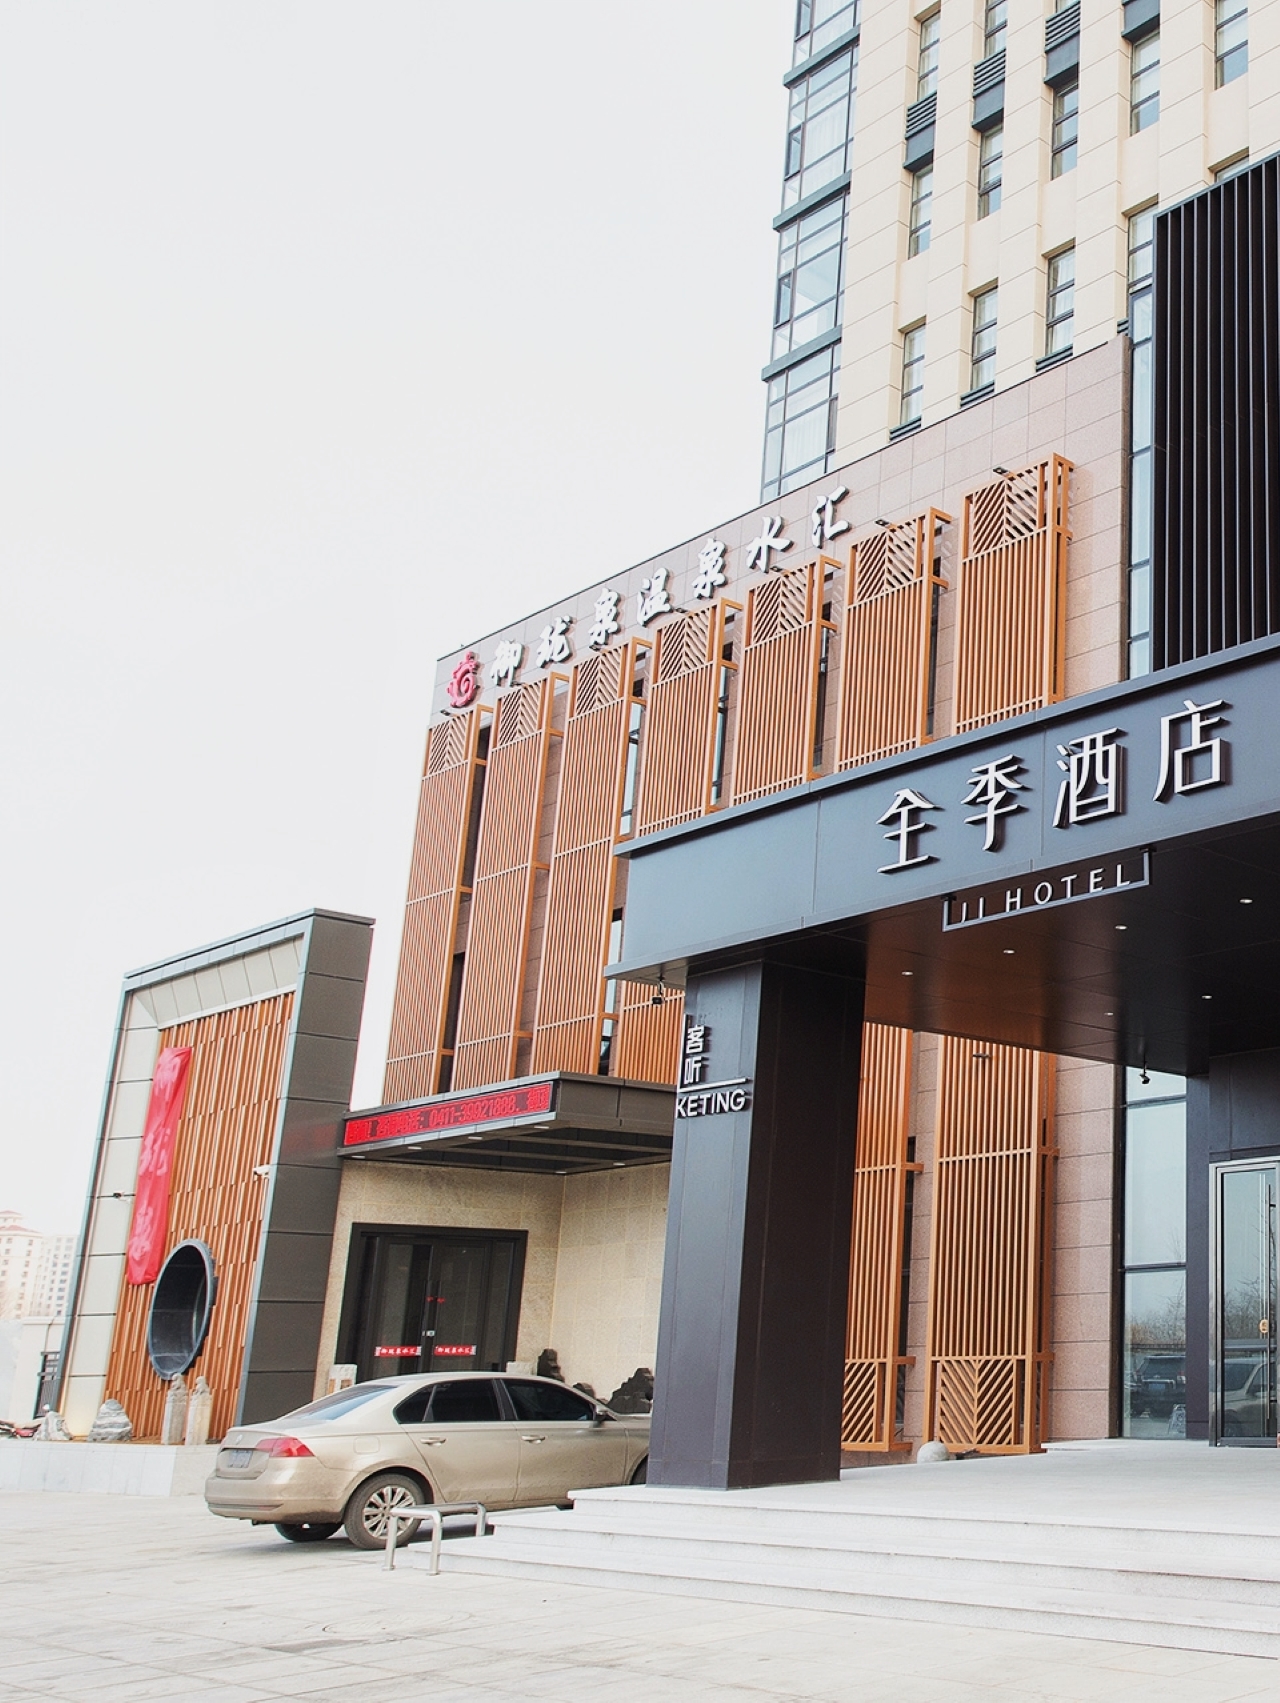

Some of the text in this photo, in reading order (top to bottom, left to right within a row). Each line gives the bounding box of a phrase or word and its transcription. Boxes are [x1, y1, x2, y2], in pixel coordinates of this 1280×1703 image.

[876, 699, 1229, 874] 全季酒店
[959, 863, 1132, 924] JI HOTEL
[675, 1088, 746, 1118] KETING
